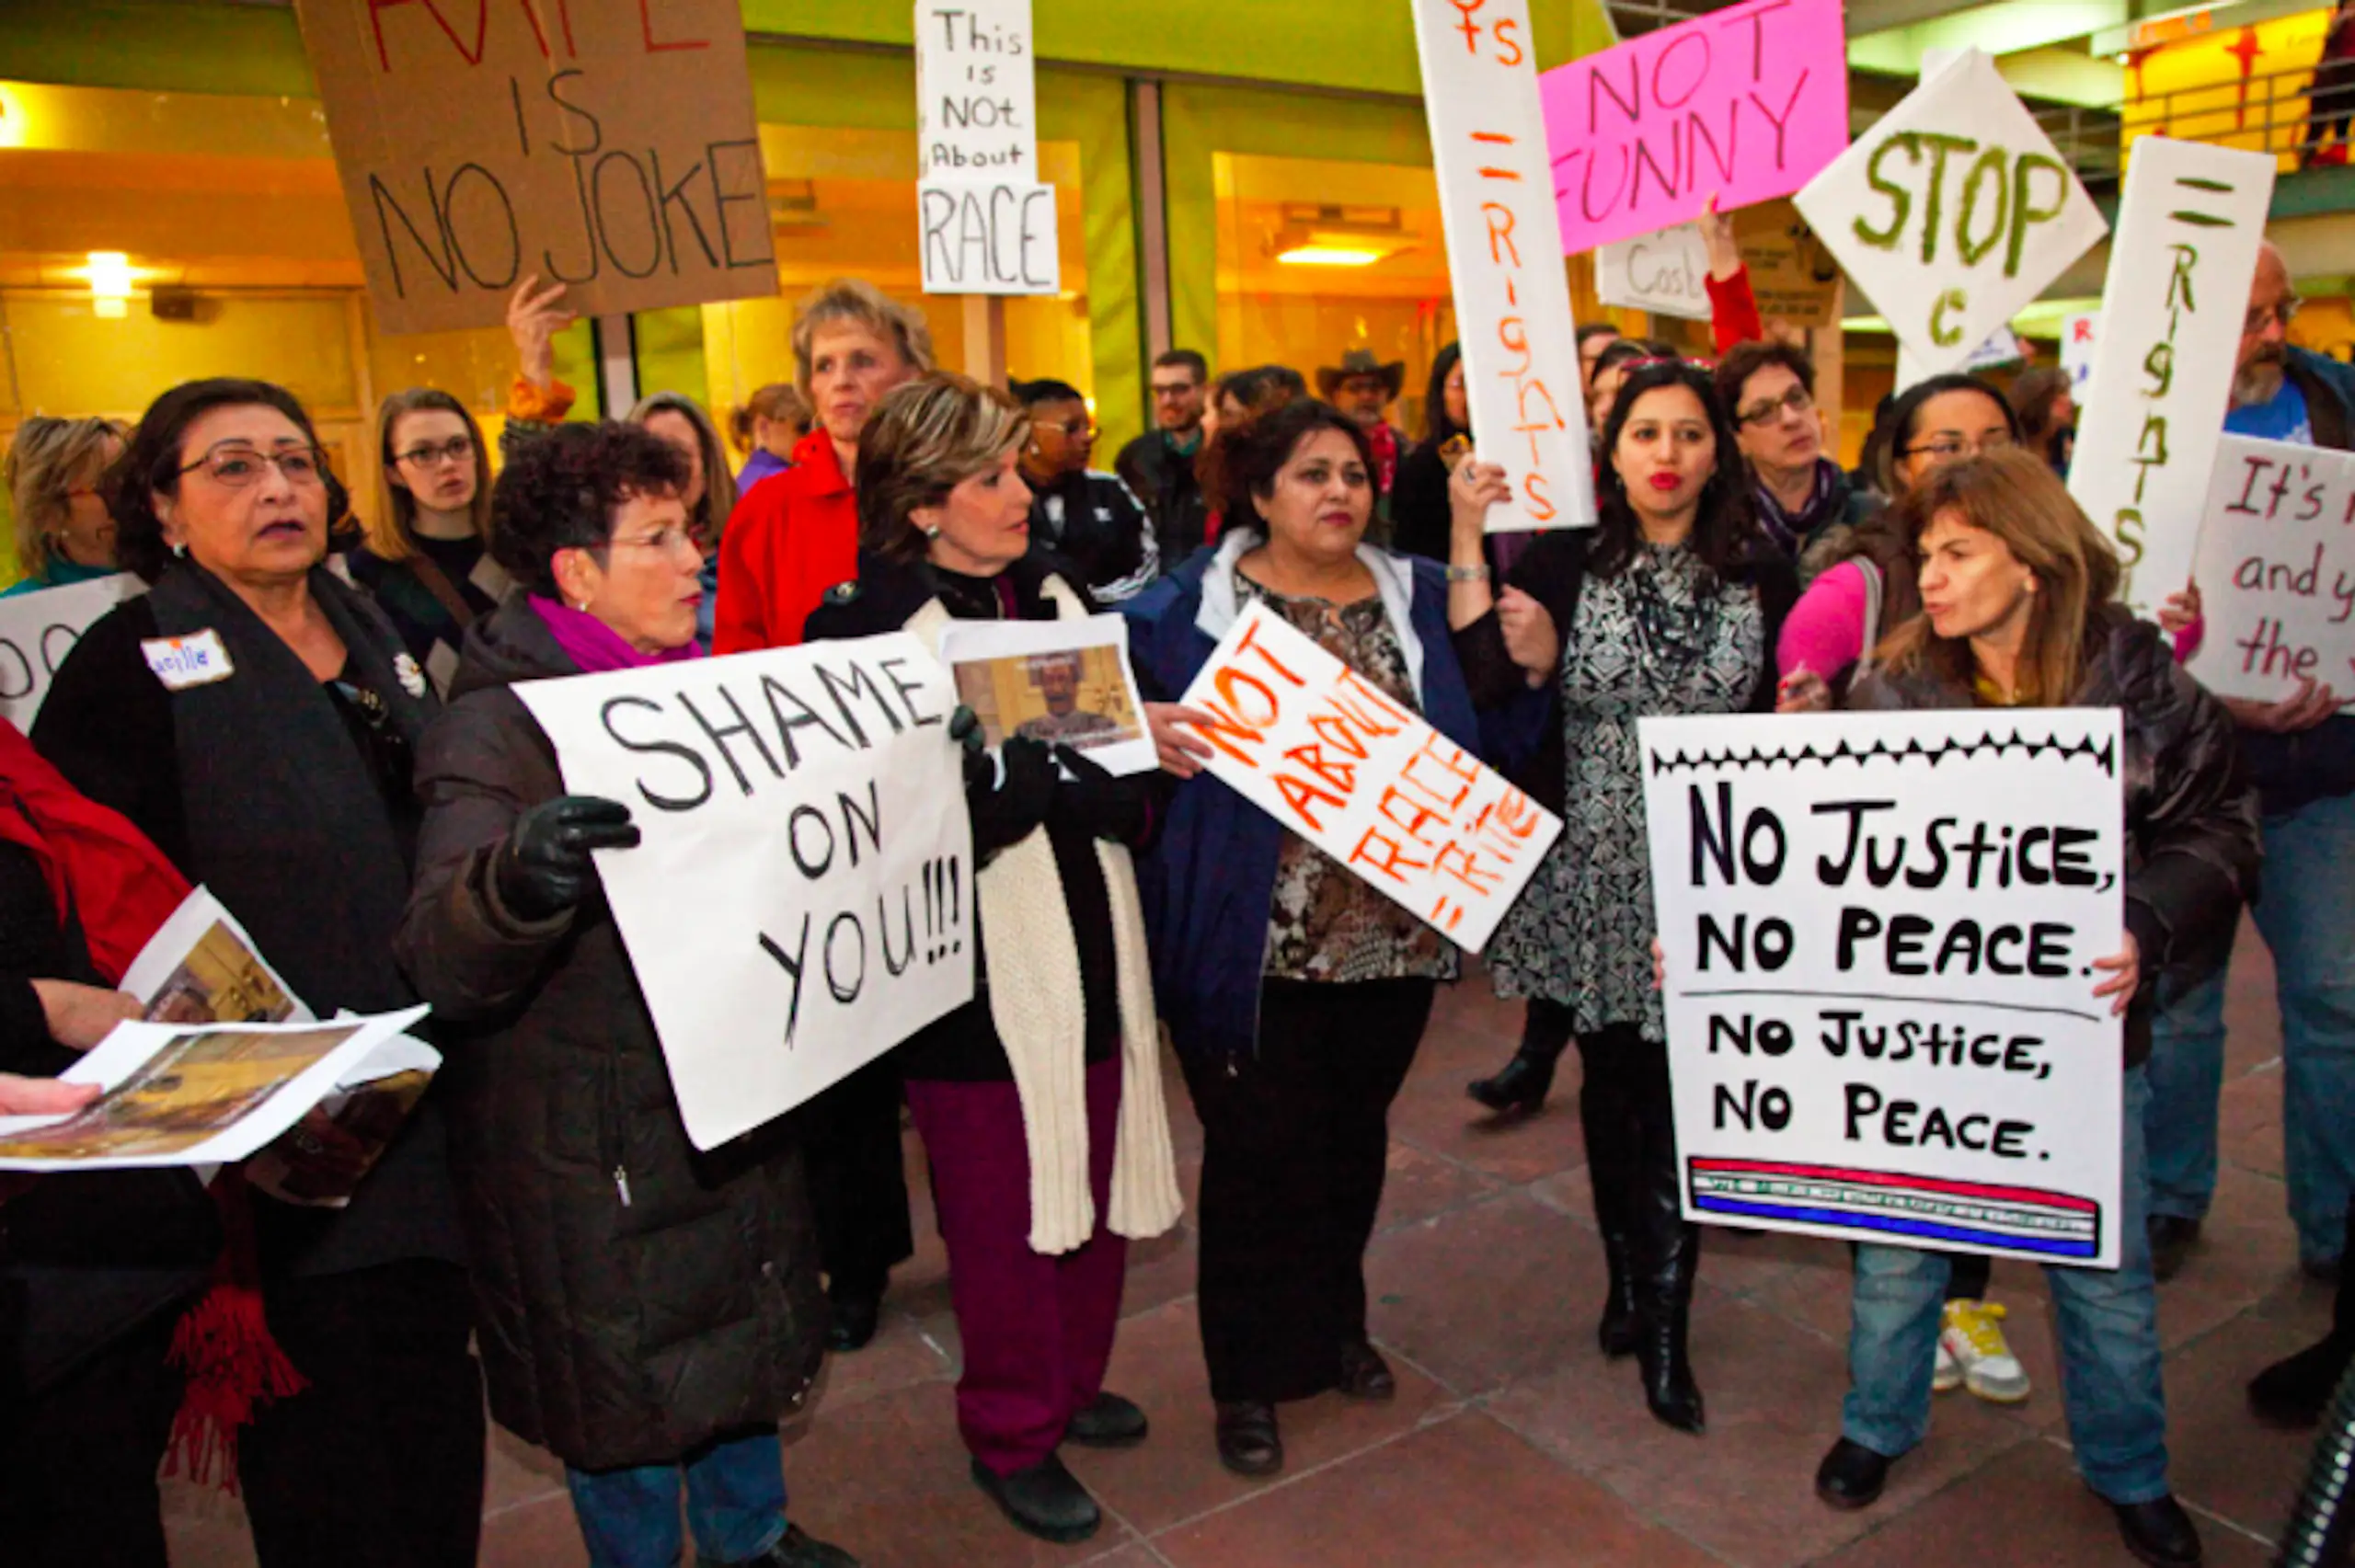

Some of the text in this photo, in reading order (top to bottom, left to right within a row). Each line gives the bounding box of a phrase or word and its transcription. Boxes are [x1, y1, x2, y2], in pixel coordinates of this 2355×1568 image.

[932, 9, 1023, 55] This
[1589, 0, 1792, 134] NOT
[511, 68, 601, 157] IS
[931, 142, 1025, 168] About
[370, 139, 774, 299] NO JOKE
[922, 185, 1052, 287] RACE
[1852, 130, 2070, 278] STOP
[2224, 456, 2326, 521] It's
[2232, 541, 2325, 596] and
[1190, 616, 1307, 770] NOT
[2234, 617, 2319, 682] the
[601, 657, 943, 812] SHAME
[1268, 665, 1411, 833] ABOUT
[788, 780, 881, 880] ON
[1349, 730, 1484, 885] RACE
[1689, 781, 1787, 887] NO
[757, 854, 962, 1050] YOU!!!
[1695, 906, 2094, 978] NO PEACE.
[1707, 1013, 1795, 1057] NO
[1713, 1079, 2051, 1161] NO PEACE.
